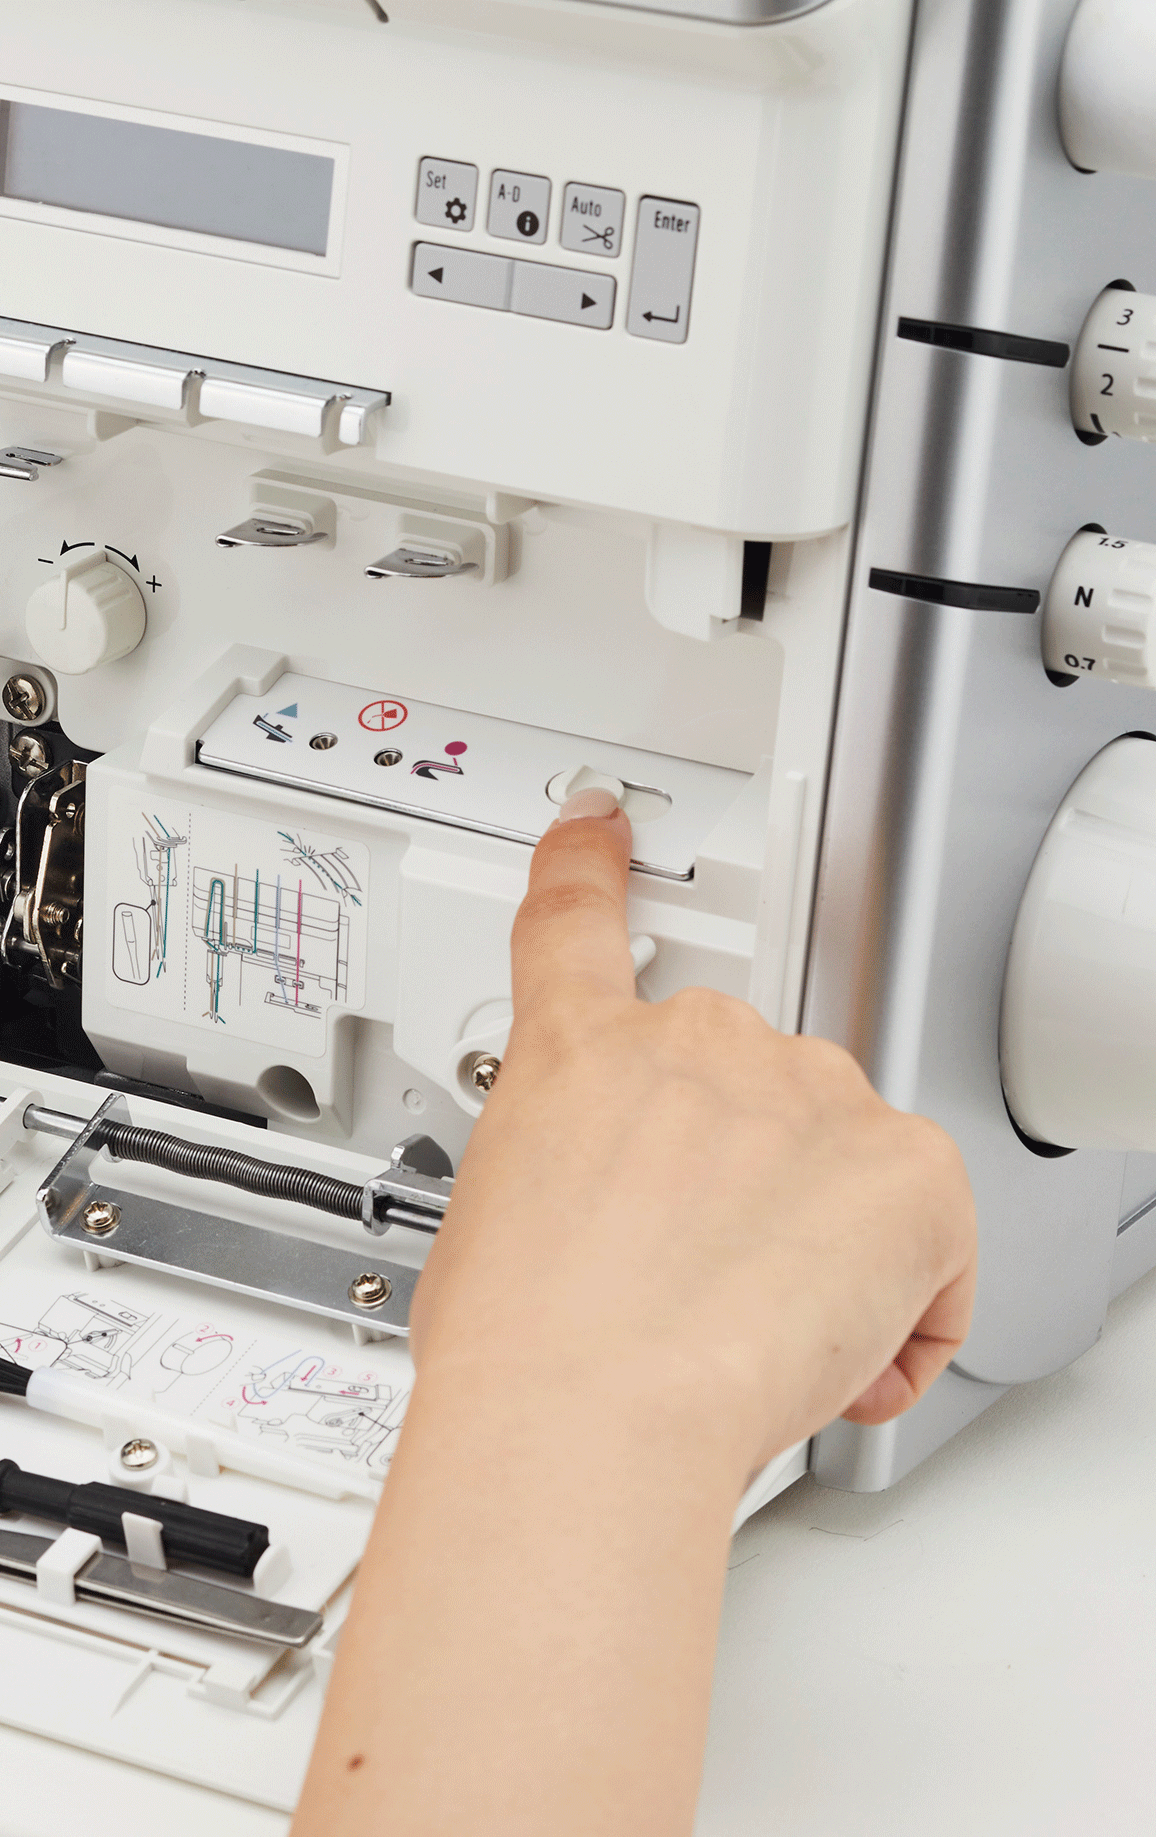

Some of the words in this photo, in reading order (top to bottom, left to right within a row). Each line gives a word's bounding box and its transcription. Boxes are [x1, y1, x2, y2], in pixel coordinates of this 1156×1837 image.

[426, 171, 447, 190] Set
[570, 197, 602, 218] Auto
[653, 210, 692, 233] Enter
[1116, 308, 1134, 326] 3
[1100, 373, 1114, 396] 2
[1098, 537, 1129, 549] 1.5
[1074, 586, 1094, 608] N
[1064, 653, 1096, 671] 0.7
